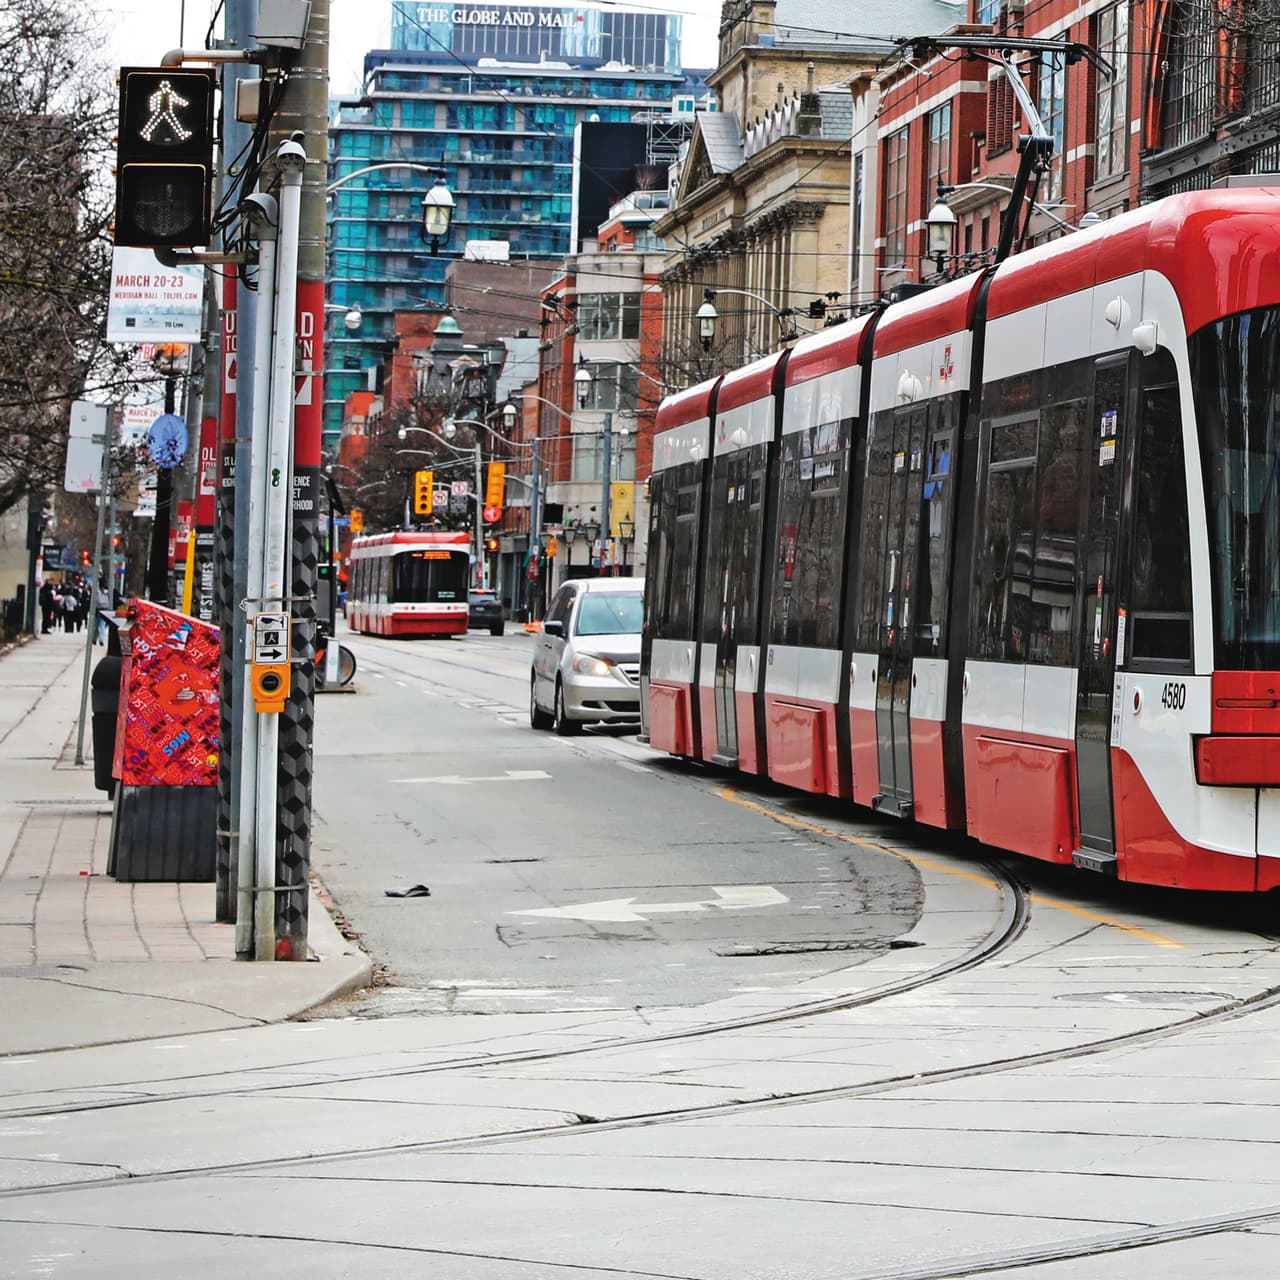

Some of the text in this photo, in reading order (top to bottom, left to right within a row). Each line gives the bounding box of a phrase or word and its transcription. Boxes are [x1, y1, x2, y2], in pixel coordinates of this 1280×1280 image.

[417, 8, 577, 29] THE GLOBE AND MAIL
[116, 275, 184, 288] MARCH 20-23
[115, 291, 142, 299] MERIDIAN
[1161, 682, 1186, 710] 4580
